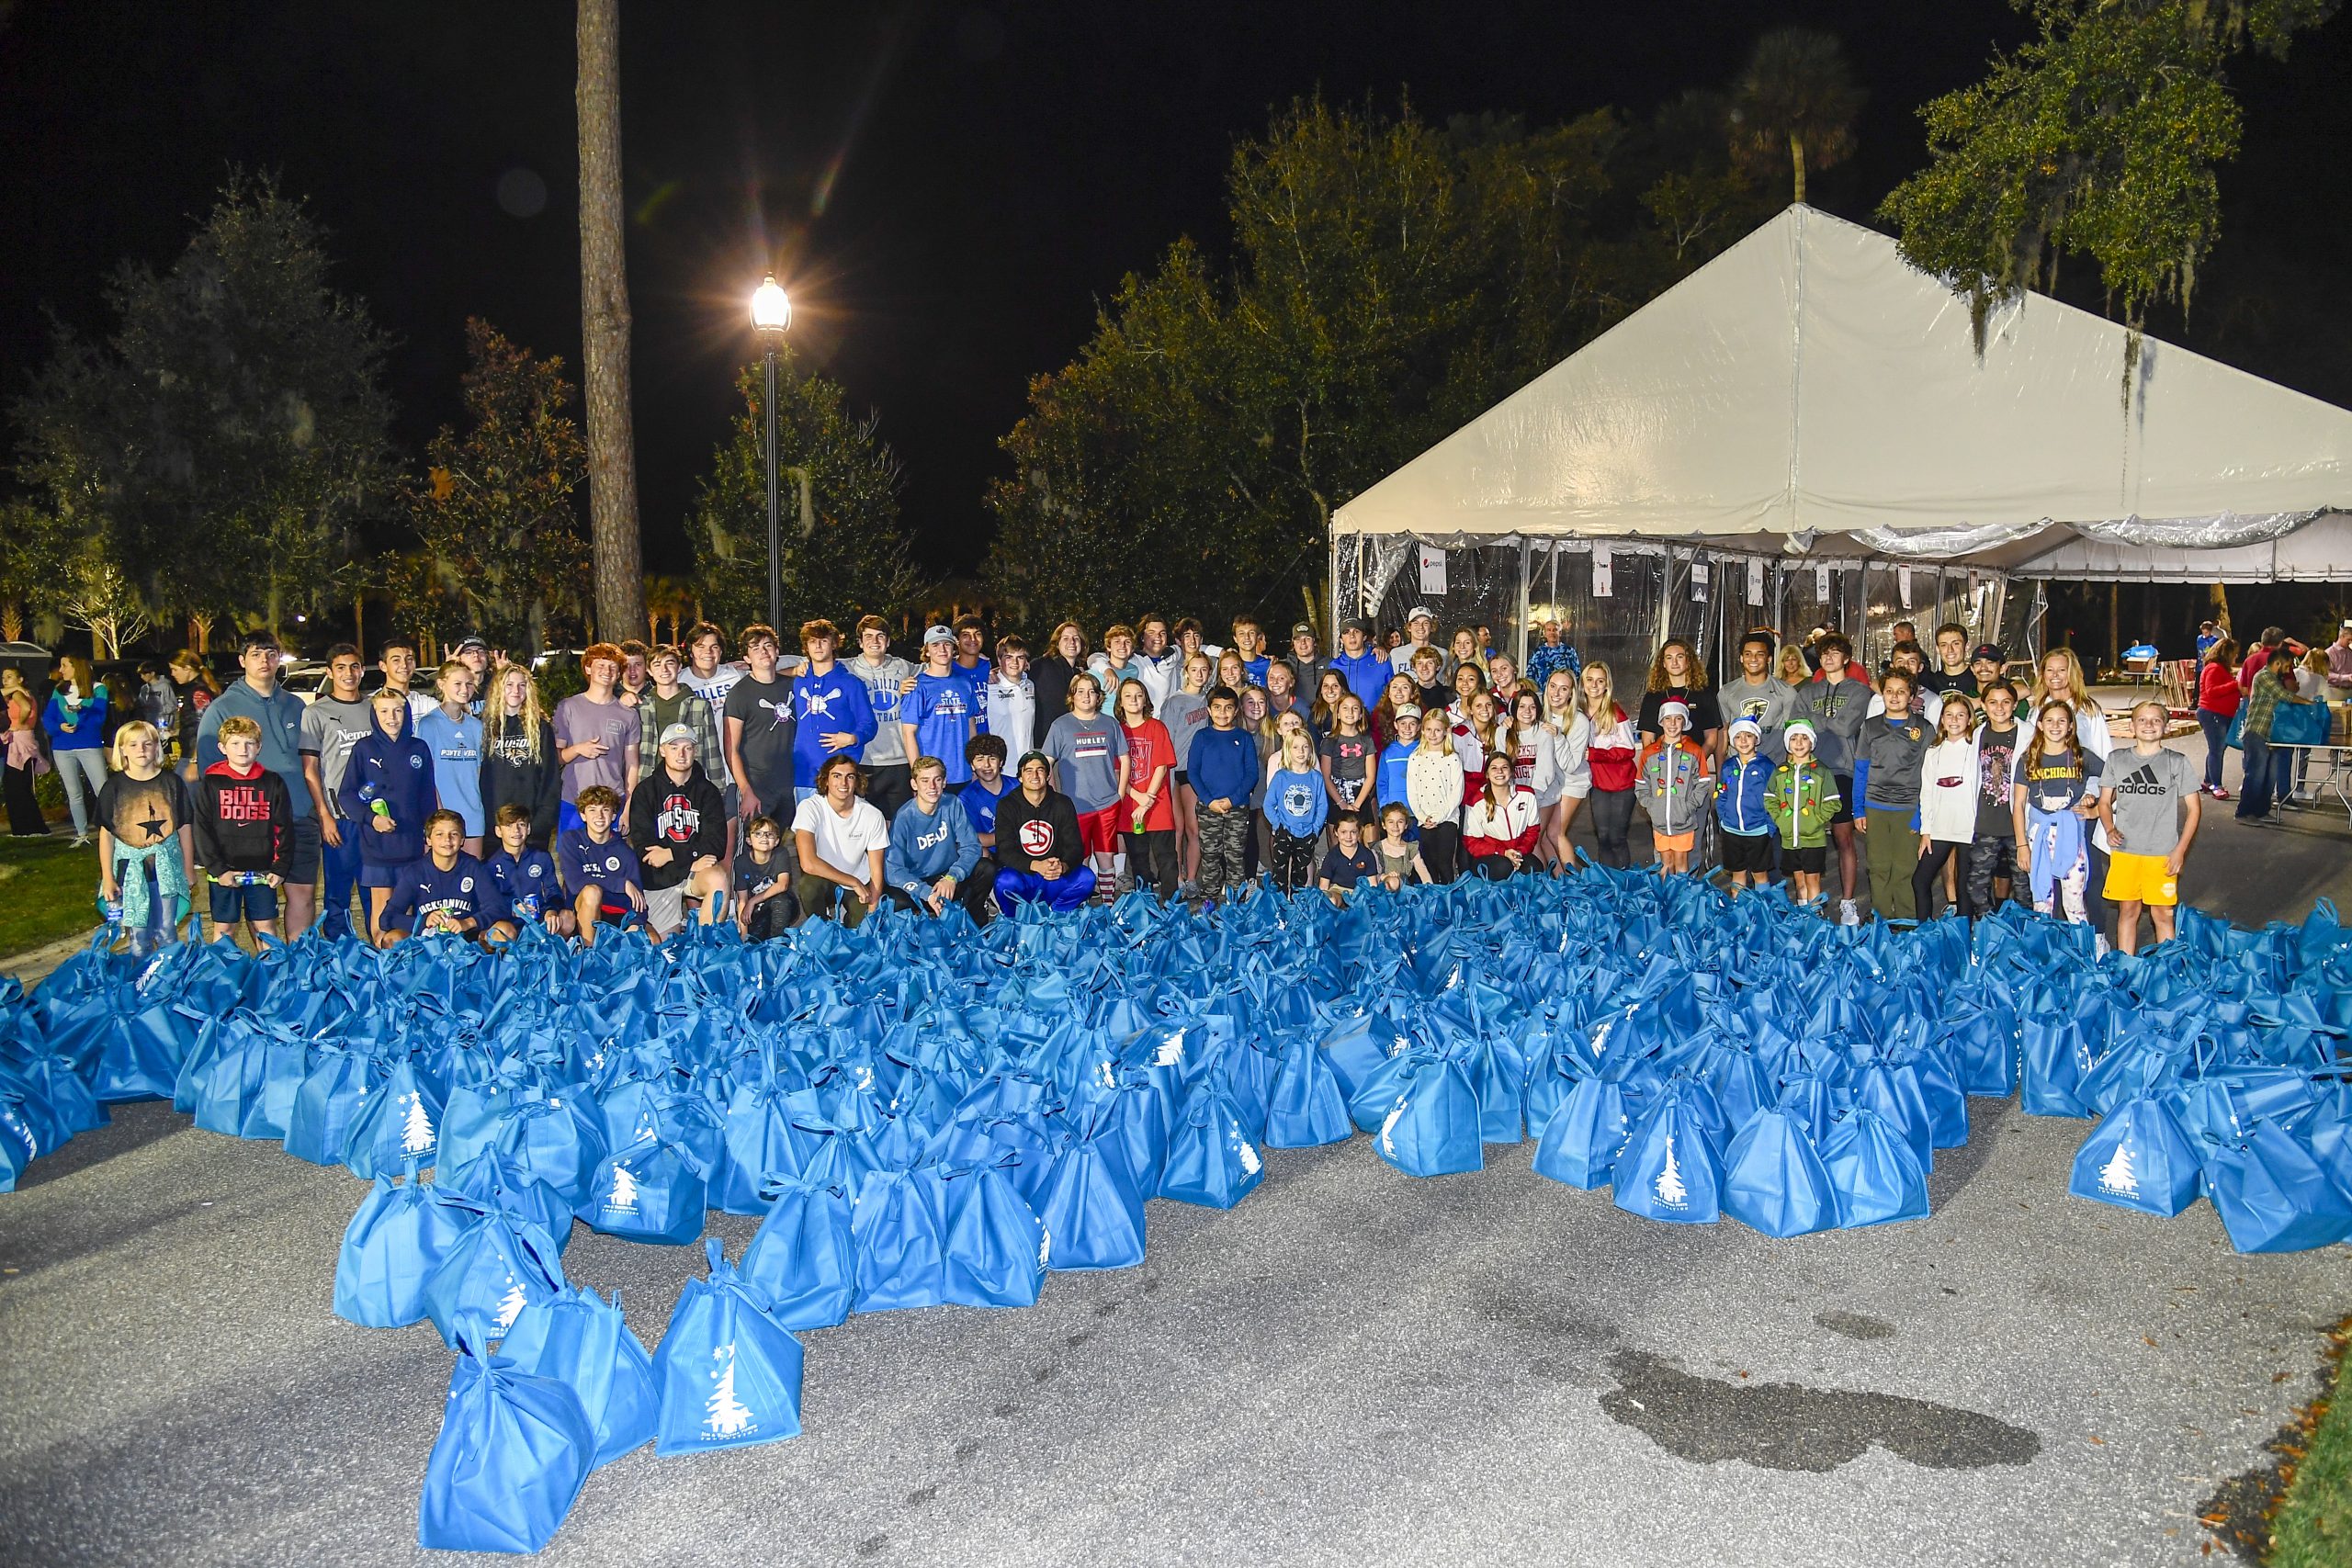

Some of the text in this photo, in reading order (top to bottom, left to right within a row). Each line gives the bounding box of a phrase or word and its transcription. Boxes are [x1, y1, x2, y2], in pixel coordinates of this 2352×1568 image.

[1076, 737, 1106, 745] HURLEY
[2117, 783, 2166, 795] adidas
[220, 789, 270, 806] BULL
[220, 805, 270, 820] DOGS
[917, 825, 948, 851] DEAD
[495, 864, 503, 873] 3
